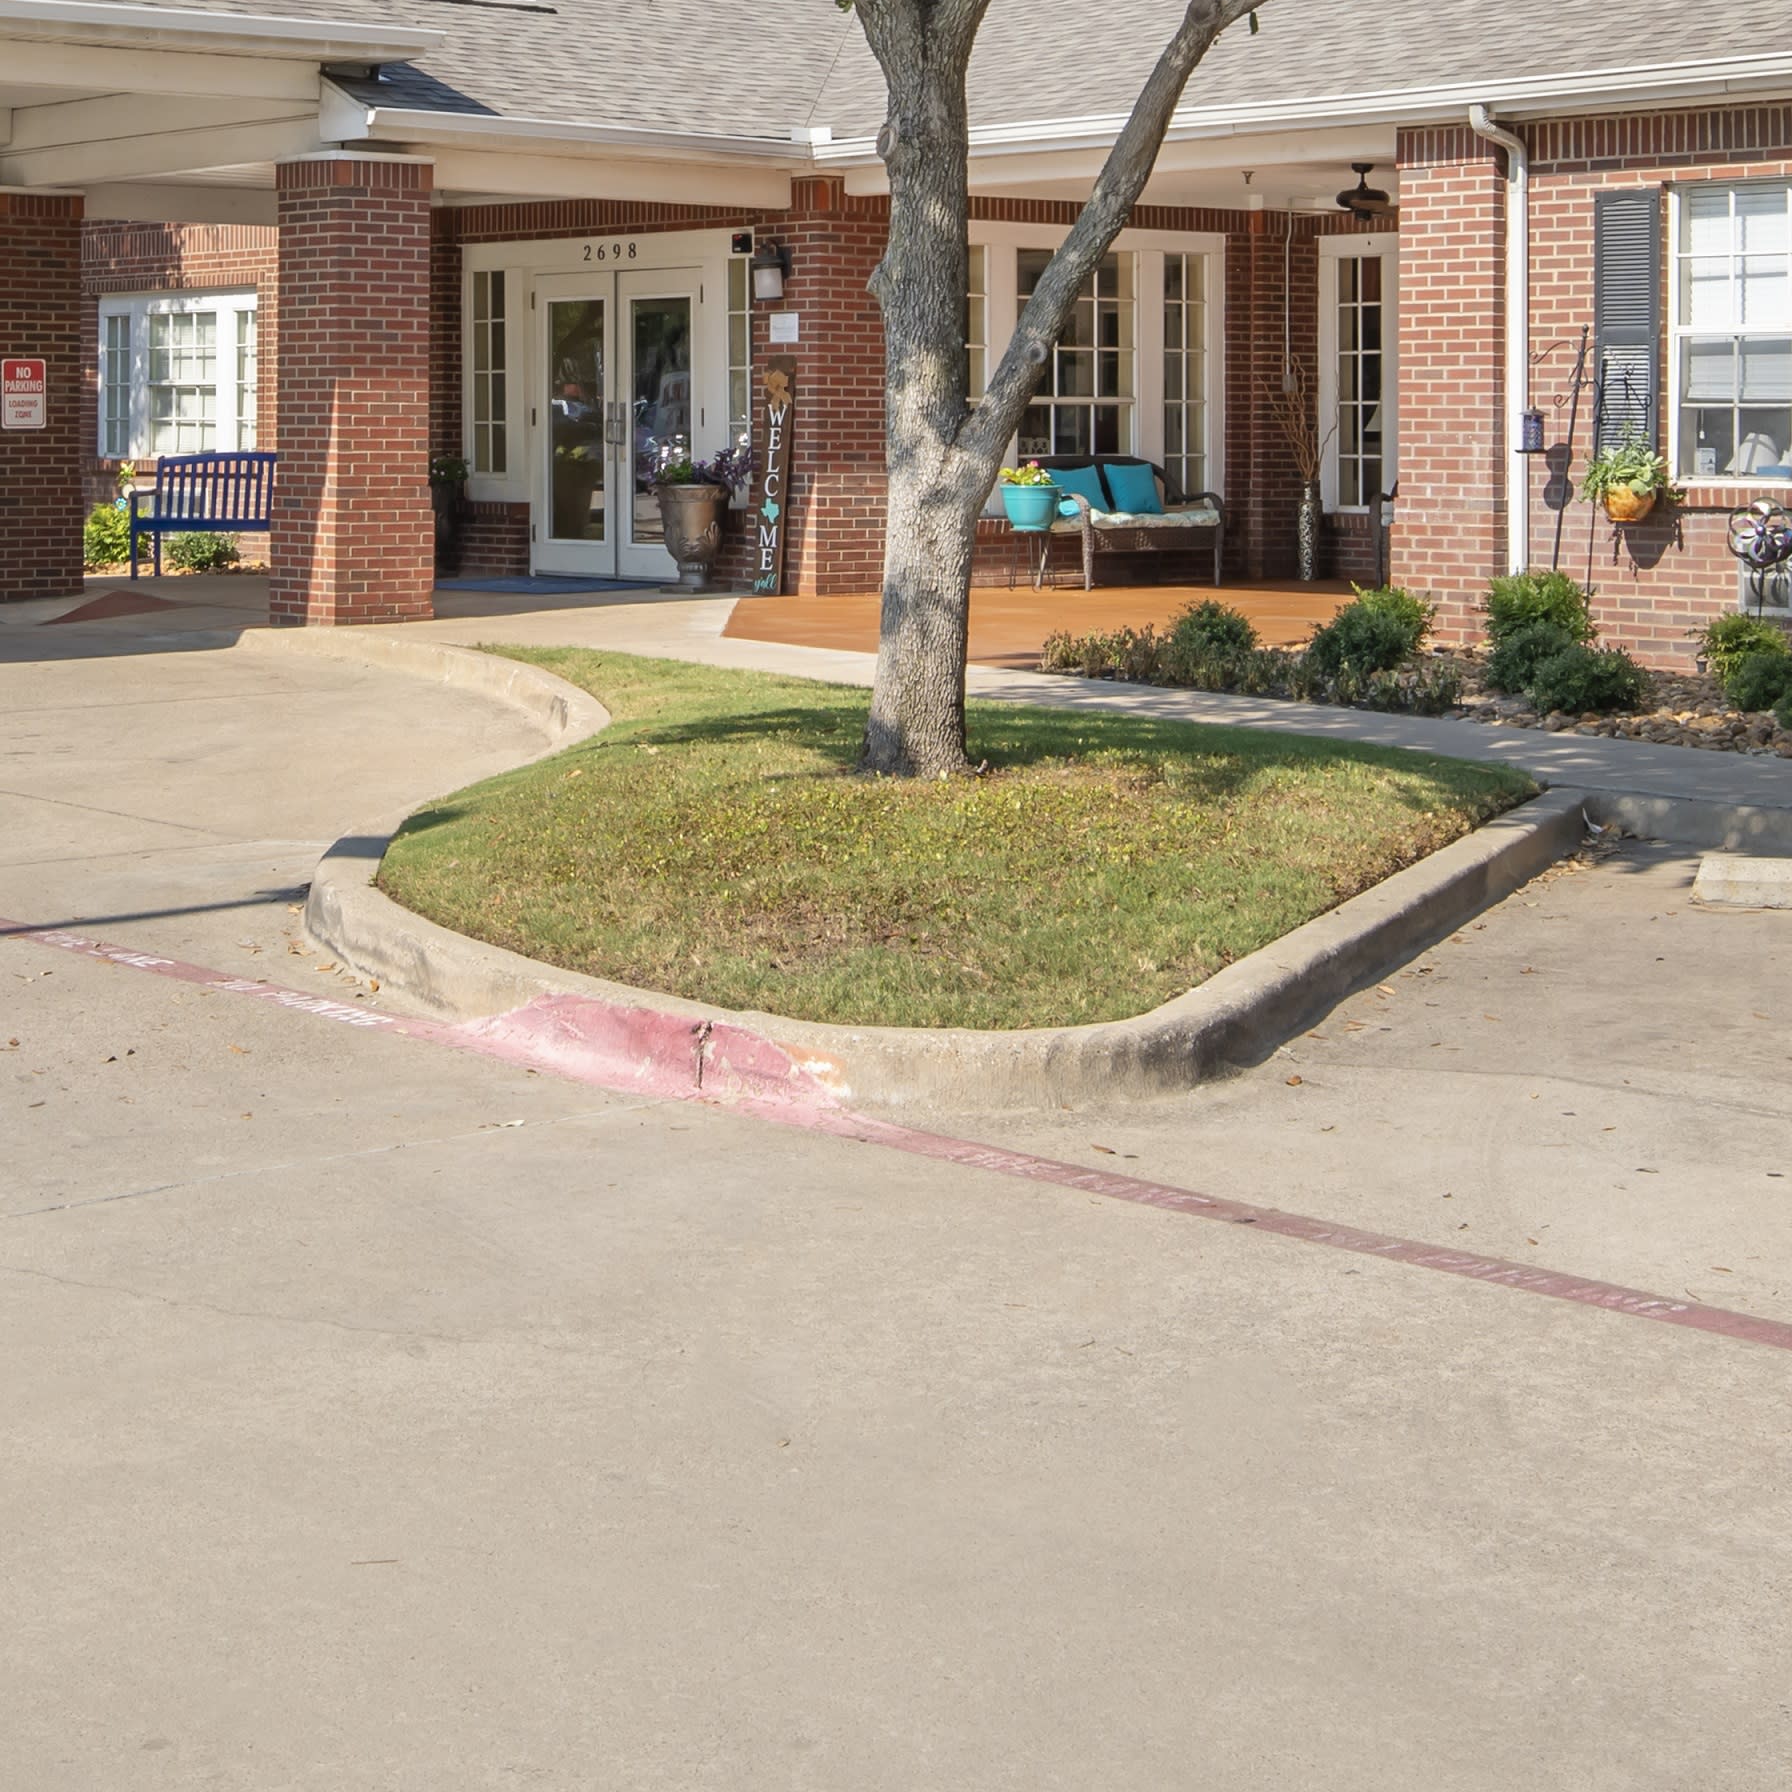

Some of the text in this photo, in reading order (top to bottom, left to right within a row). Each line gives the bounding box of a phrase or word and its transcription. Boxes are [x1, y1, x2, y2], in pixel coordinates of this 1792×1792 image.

[583, 242, 637, 261] 2698
[15, 366, 32, 379] NO
[4, 380, 43, 393] PARKING
[8, 399, 38, 408] LOADING
[14, 410, 33, 419] ZONE
[759, 402, 788, 571] WELCME
